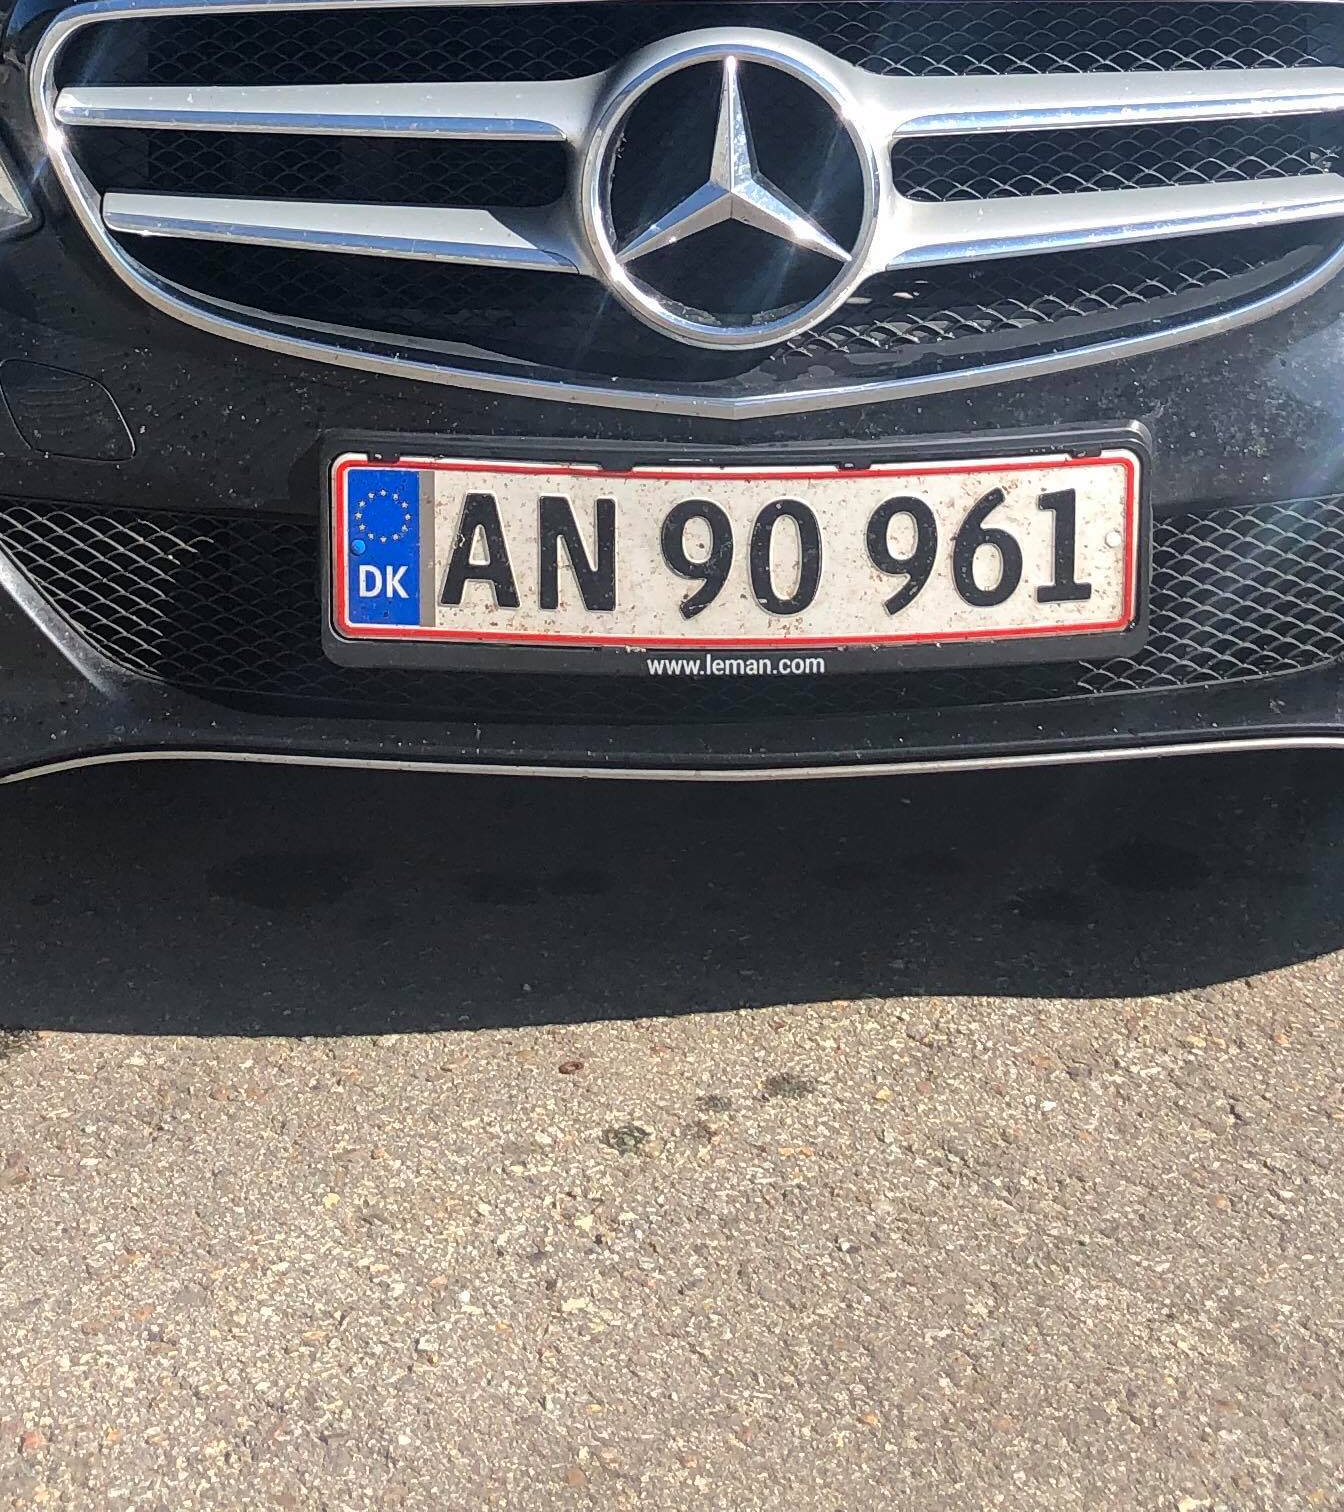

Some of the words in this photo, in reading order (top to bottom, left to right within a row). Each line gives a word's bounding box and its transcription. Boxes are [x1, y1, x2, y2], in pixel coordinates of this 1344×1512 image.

[440, 492, 617, 611] AN
[660, 498, 822, 618] 90
[866, 488, 1092, 615] 961
[359, 565, 409, 598] DK
[647, 654, 825, 676] www.leman.com
